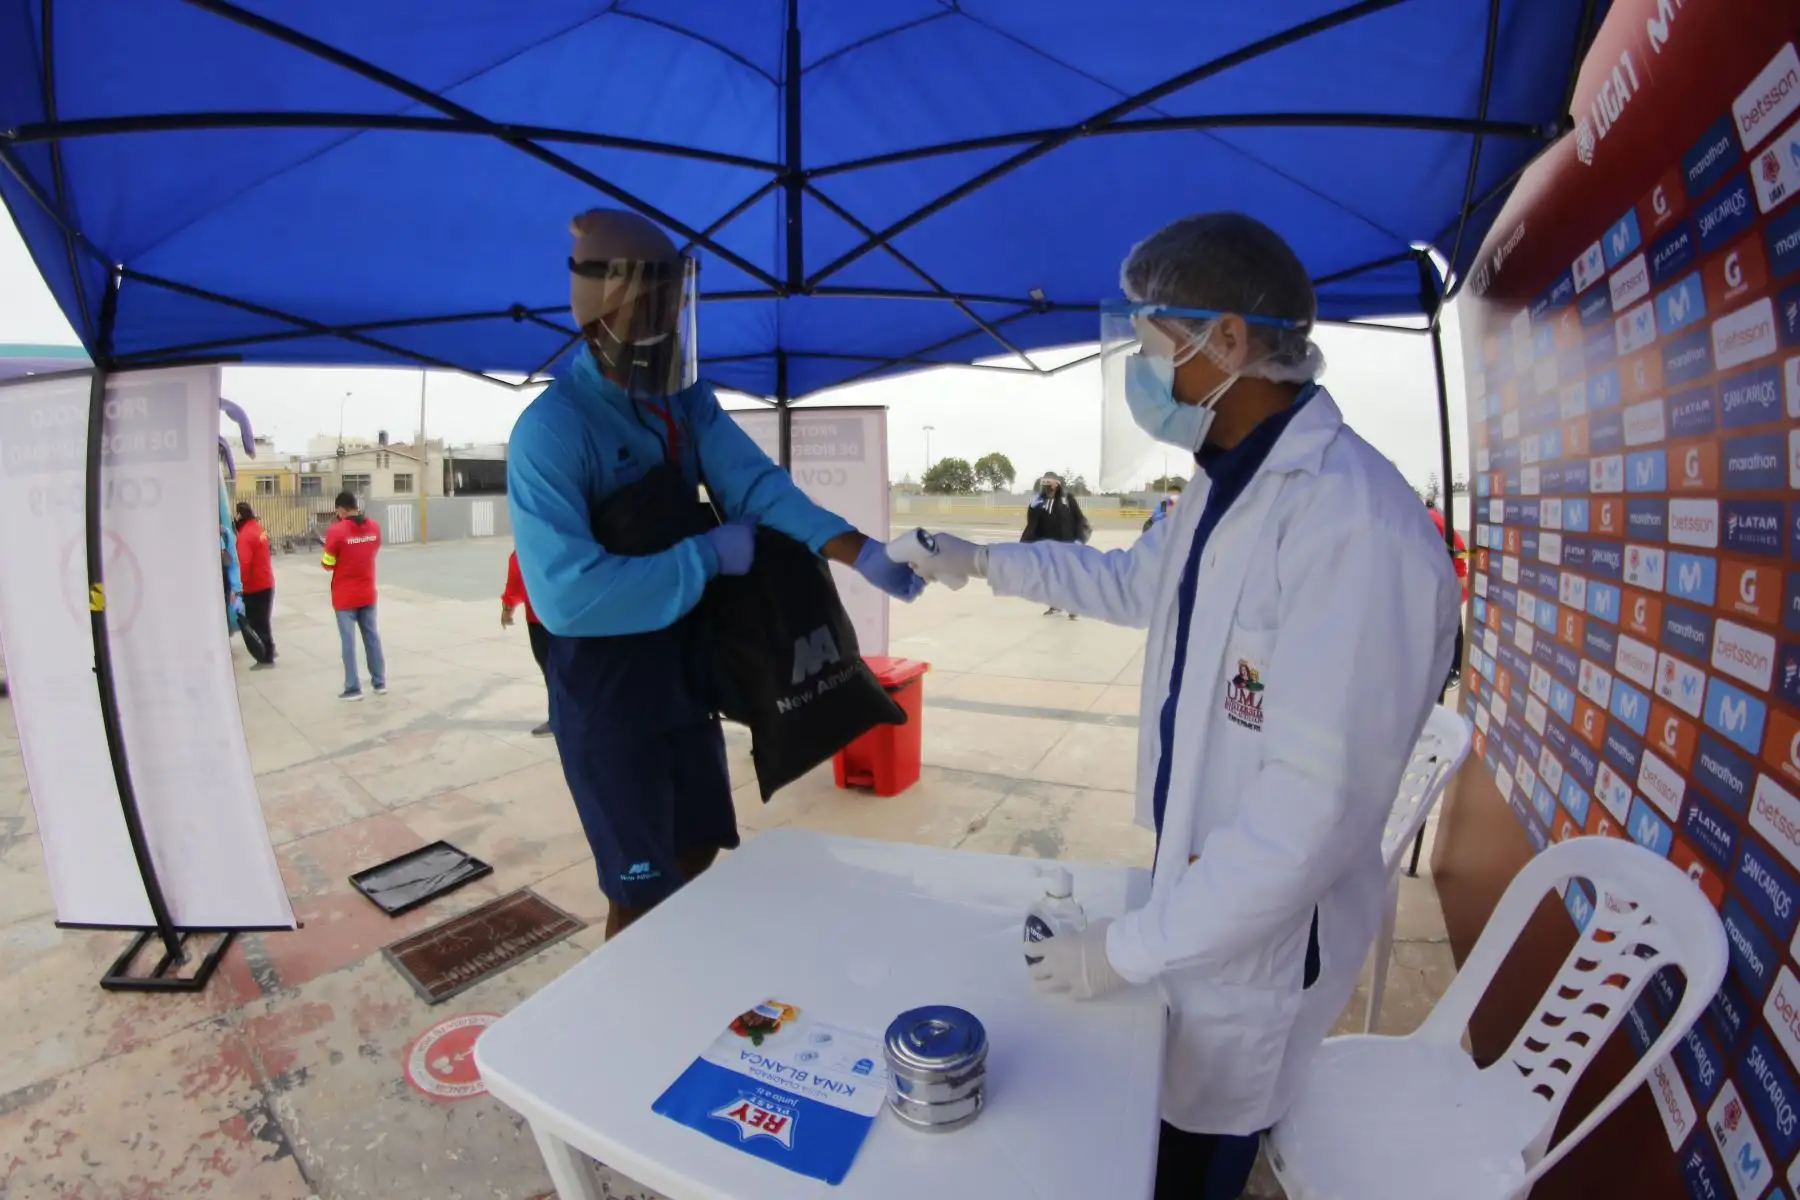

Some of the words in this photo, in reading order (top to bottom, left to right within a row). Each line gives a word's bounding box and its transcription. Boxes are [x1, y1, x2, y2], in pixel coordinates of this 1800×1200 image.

[1590, 50, 1640, 140] LIGA1
[1739, 69, 1799, 132] betsson
[1688, 136, 1730, 181] marathon
[1659, 234, 1688, 260] LATAM
[1718, 321, 1770, 355] betsson
[1680, 400, 1710, 416] LATAM
[1728, 454, 1777, 471] marathon
[1672, 513, 1714, 533] betsson
[1739, 515, 1777, 531] LATAM
[1667, 620, 1705, 645] marathon
[1717, 636, 1768, 671] betsson
[776, 691, 814, 714] New
[1641, 763, 1679, 804] betsson
[1701, 753, 1744, 794] marathon
[1697, 810, 1731, 849] LATAM
[1725, 917, 1765, 978] marathon
[740, 1050, 808, 1082] BLANCA
[749, 1066, 800, 1089] CUADRADA
[770, 1093, 799, 1107] junto
[813, 1075, 857, 1097] KINA
[728, 1103, 788, 1134] REY
[749, 1097, 790, 1115] PLAST
